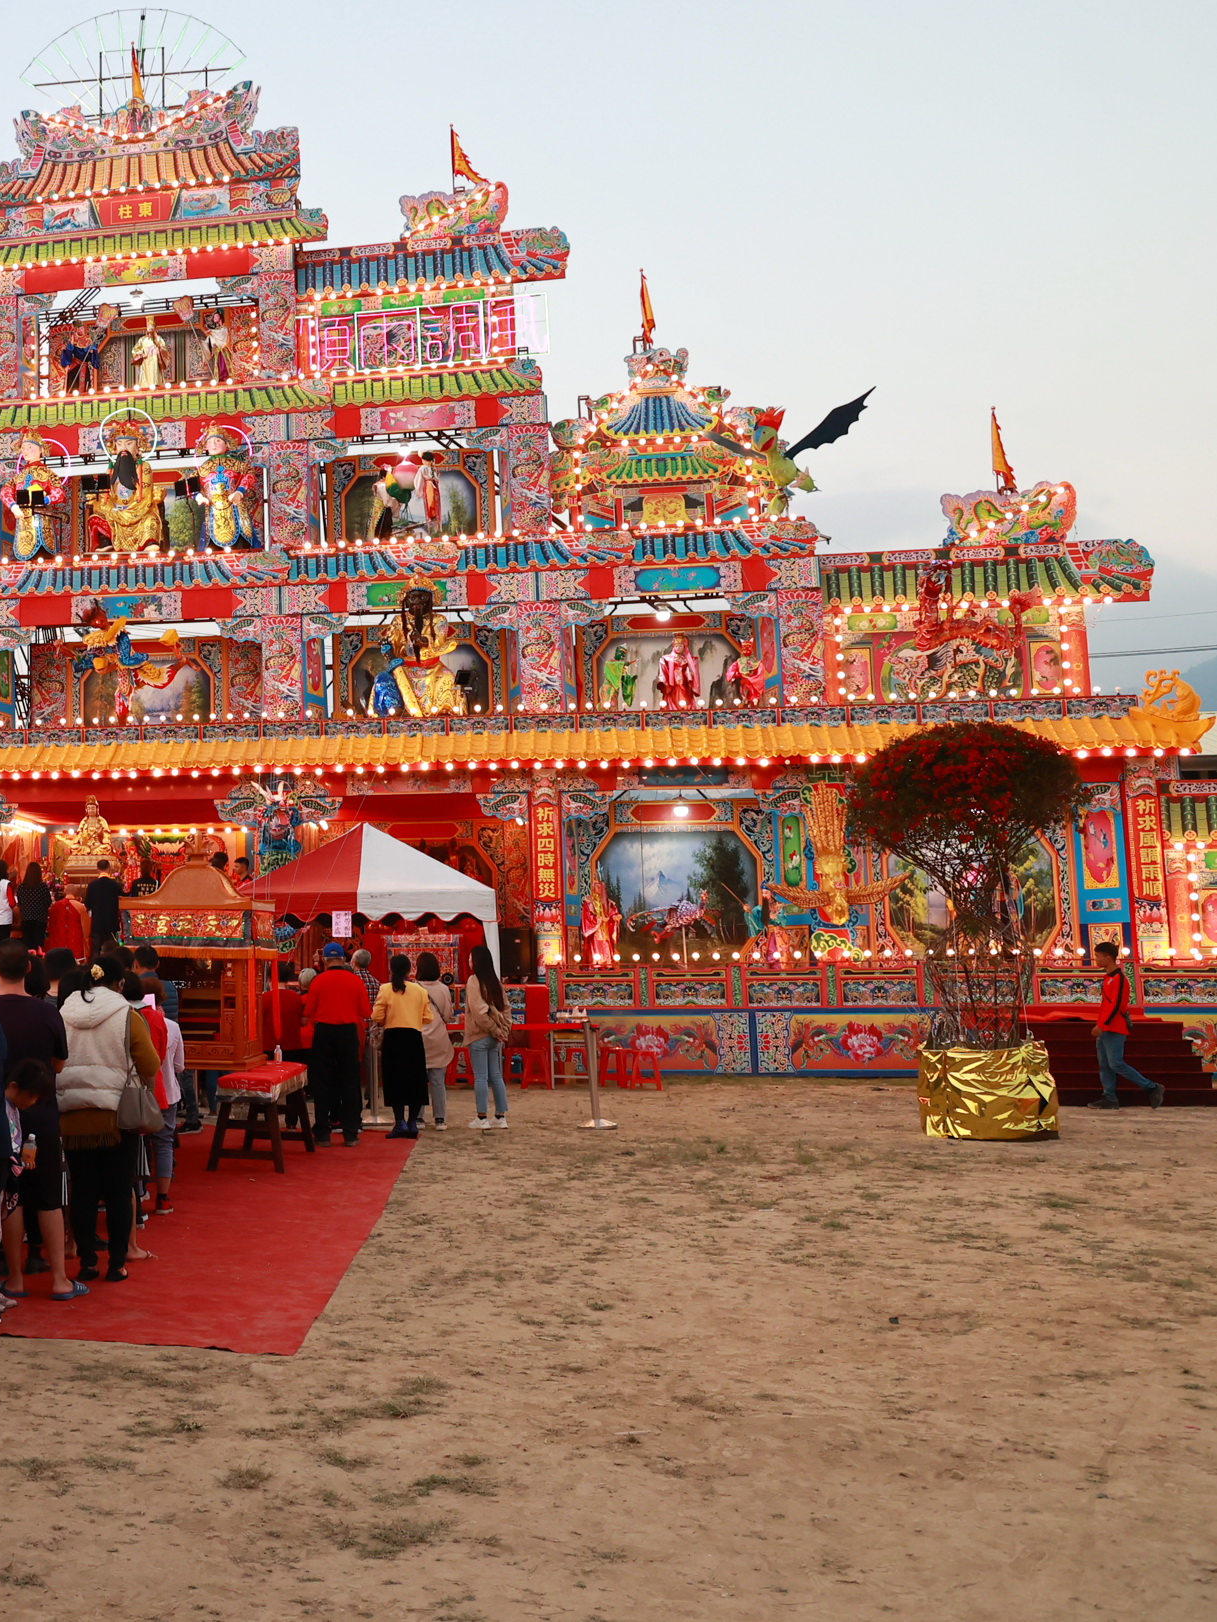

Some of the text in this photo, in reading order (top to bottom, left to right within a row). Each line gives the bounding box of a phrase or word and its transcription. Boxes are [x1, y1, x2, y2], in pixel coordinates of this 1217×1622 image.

[536, 806, 556, 898] 祈求四時無災
[1135, 798, 1164, 897] 祈求風調雨順
